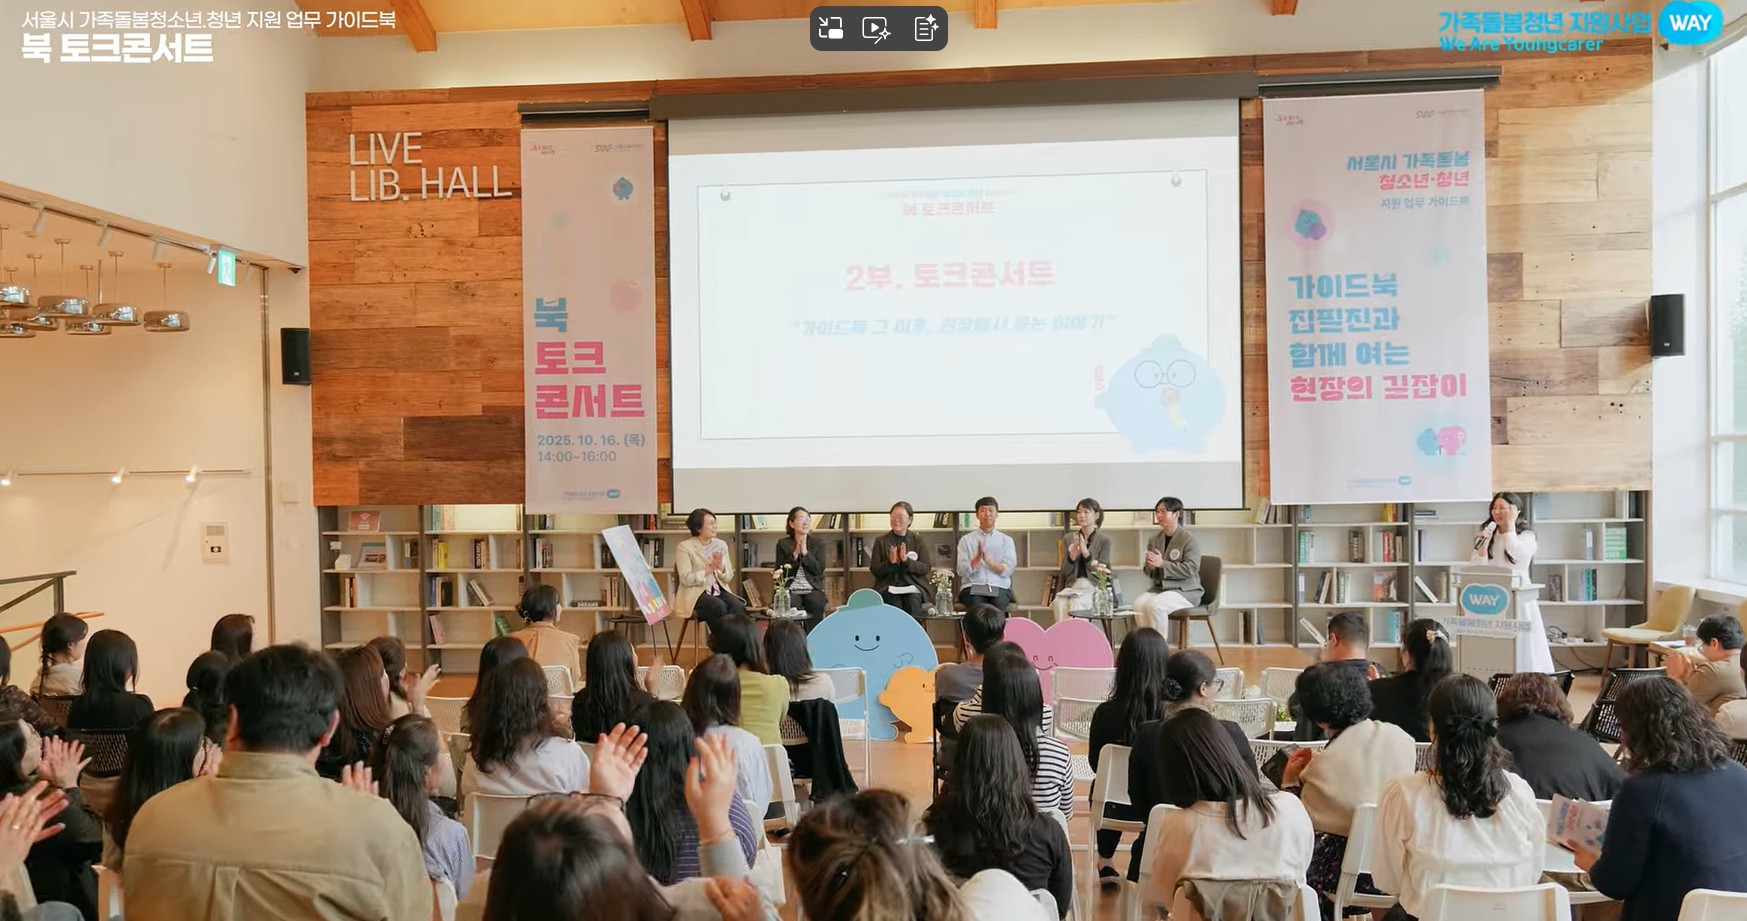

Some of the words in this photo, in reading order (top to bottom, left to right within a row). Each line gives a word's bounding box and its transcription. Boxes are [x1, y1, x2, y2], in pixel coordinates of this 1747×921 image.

[350, 132, 423, 166] LIVE
[1346, 154, 1398, 171] 서울시
[350, 168, 410, 202] LIB.
[421, 165, 513, 199] HALL
[846, 263, 903, 291] 2부.
[914, 260, 1057, 289] 토크콘서트
[1288, 273, 1398, 300] 가이드북
[534, 297, 568, 332] 북
[1288, 307, 1401, 334] 집필진과
[535, 341, 606, 375] 토크
[1290, 342, 1347, 369] 함께
[1355, 342, 1411, 366] 여는
[535, 384, 645, 419] 콘서트
[1290, 375, 1373, 402] 현장의
[1382, 373, 1468, 400] 길잡이
[537, 435, 574, 447] 2025.
[579, 435, 597, 446] 10.
[601, 435, 619, 446] 16.
[624, 433, 645, 447] (목)
[537, 451, 617, 462] 14:00~16:00
[1469, 594, 1500, 607] WAY
